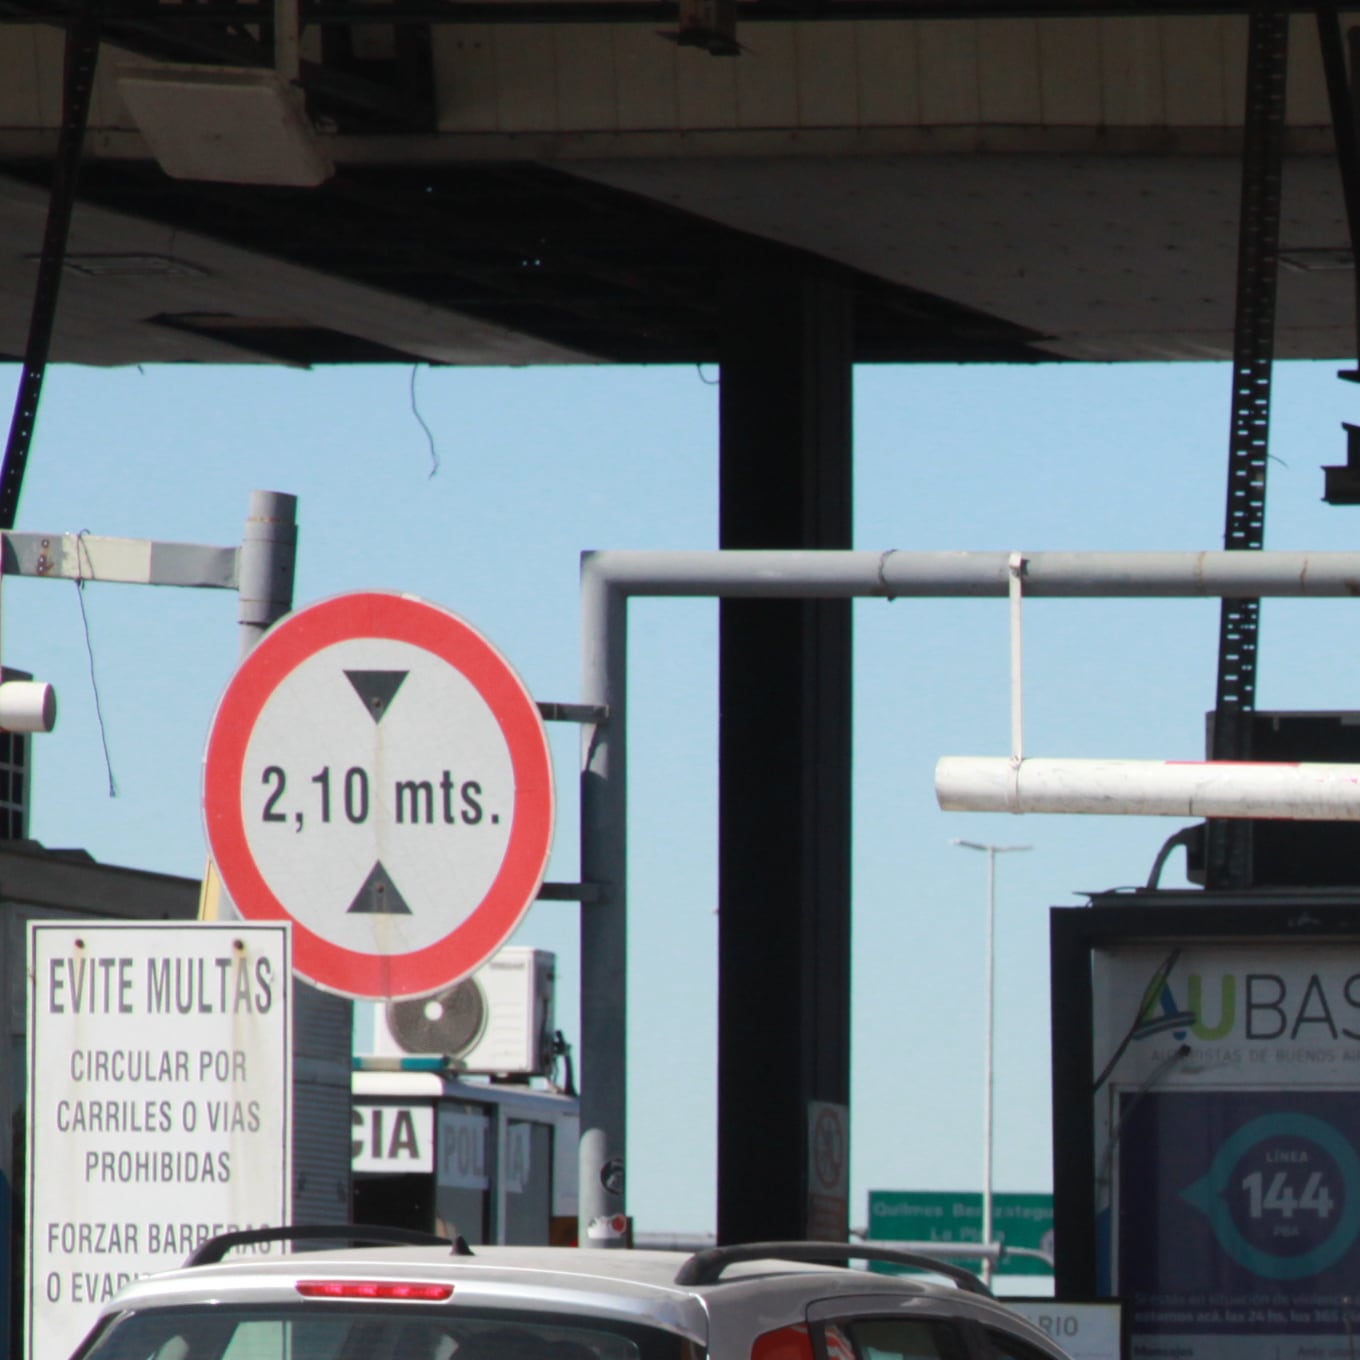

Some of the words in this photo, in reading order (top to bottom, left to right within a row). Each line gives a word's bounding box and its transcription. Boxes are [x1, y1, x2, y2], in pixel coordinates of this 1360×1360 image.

[262, 766, 369, 833] 2,10
[395, 770, 499, 824] mts.
[50, 957, 133, 1014] EVITE
[147, 956, 272, 1014] MULTAS
[70, 1050, 189, 1081] CIRCULAR
[200, 1050, 246, 1081] POR
[57, 1100, 172, 1132] CARRILES
[183, 1101, 197, 1132] O
[207, 1101, 261, 1132] VIAS
[85, 1151, 231, 1183] PROHIBIDAS
[1242, 1171, 1334, 1218] 144
[47, 1223, 138, 1254] FORZAR
[47, 1272, 61, 1302] O
